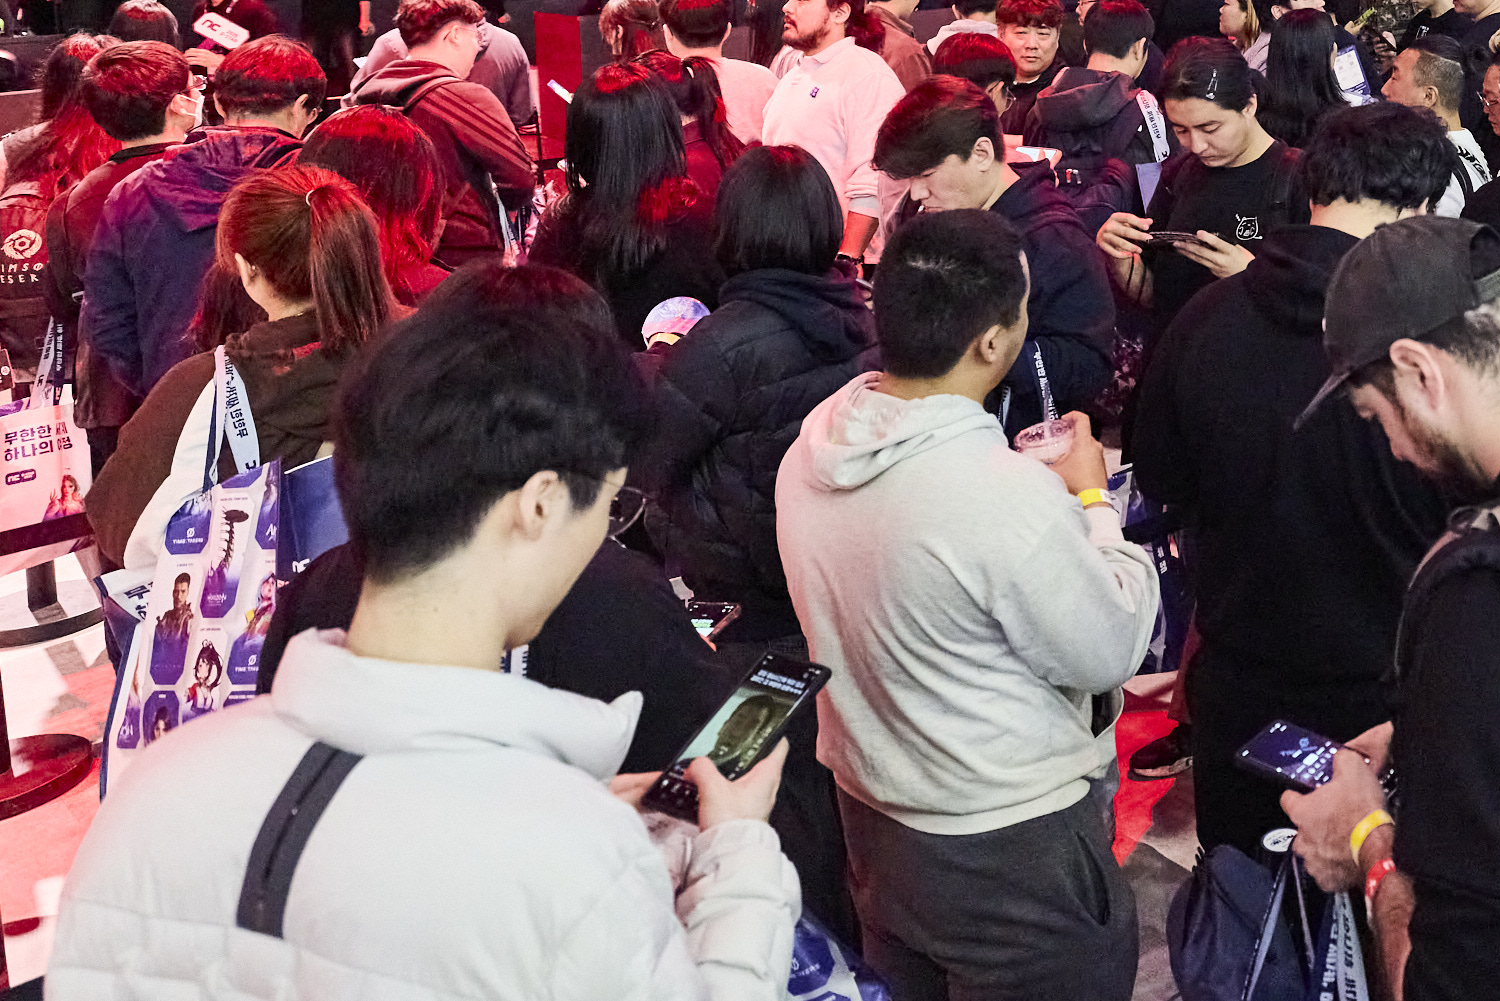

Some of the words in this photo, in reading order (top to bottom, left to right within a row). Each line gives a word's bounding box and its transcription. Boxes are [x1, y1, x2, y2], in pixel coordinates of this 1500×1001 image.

[0, 273, 40, 284] ESER
[4, 424, 52, 445] 무한한
[4, 440, 54, 462] 하나의
